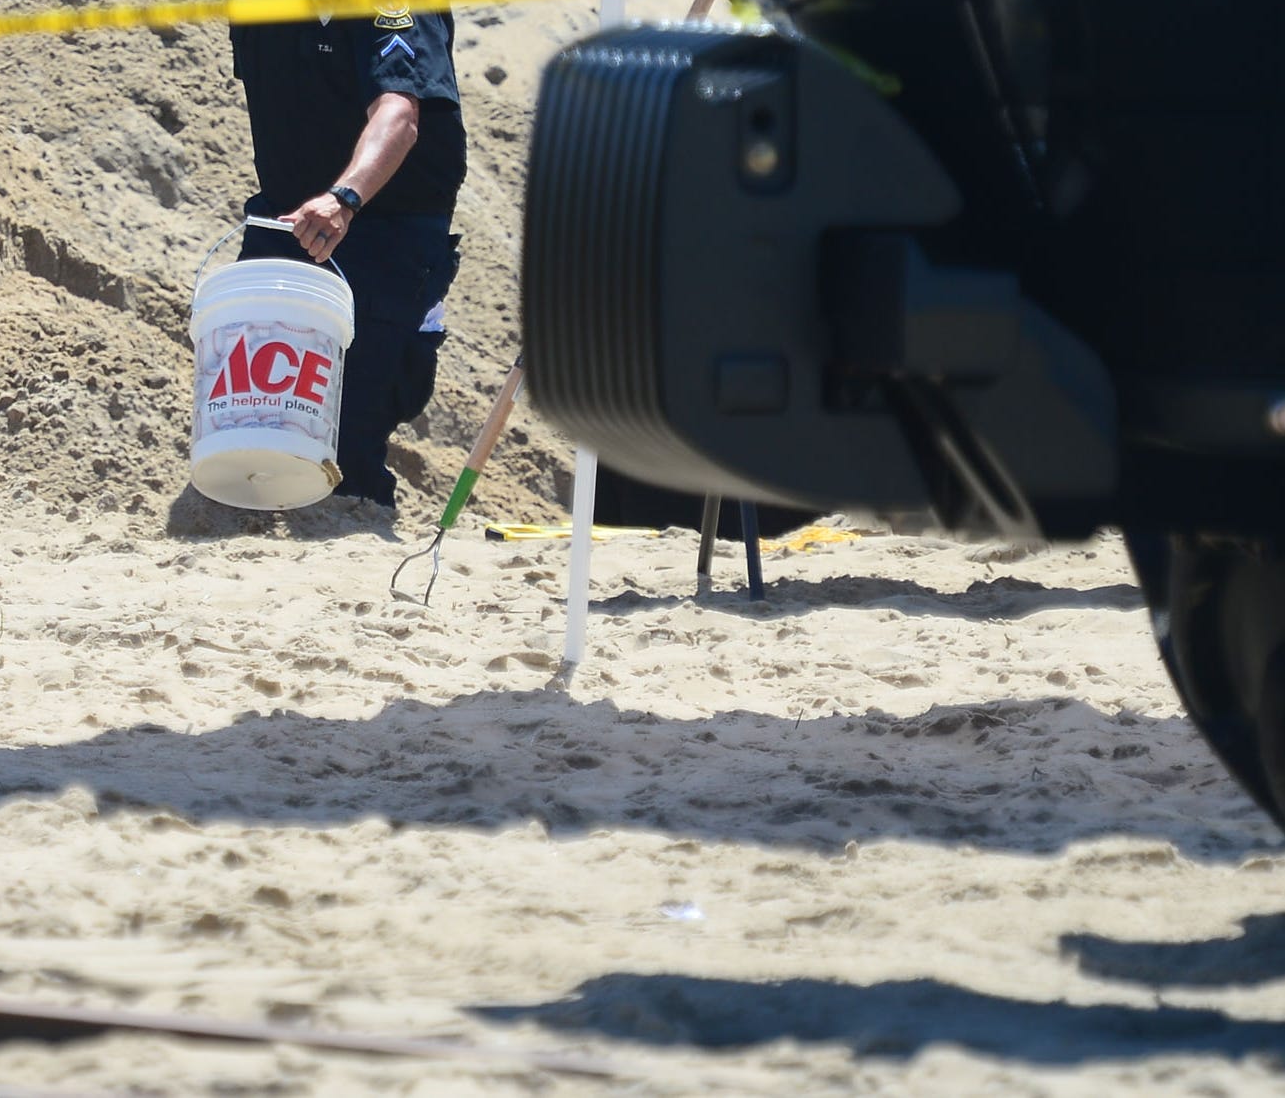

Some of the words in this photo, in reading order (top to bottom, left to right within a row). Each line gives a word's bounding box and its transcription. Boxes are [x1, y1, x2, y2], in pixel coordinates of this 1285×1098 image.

[378, 16, 411, 26] POLICE
[209, 334, 332, 405] ACE
[208, 400, 227, 412] The
[231, 395, 281, 407] helpful
[285, 399, 322, 419] place.
